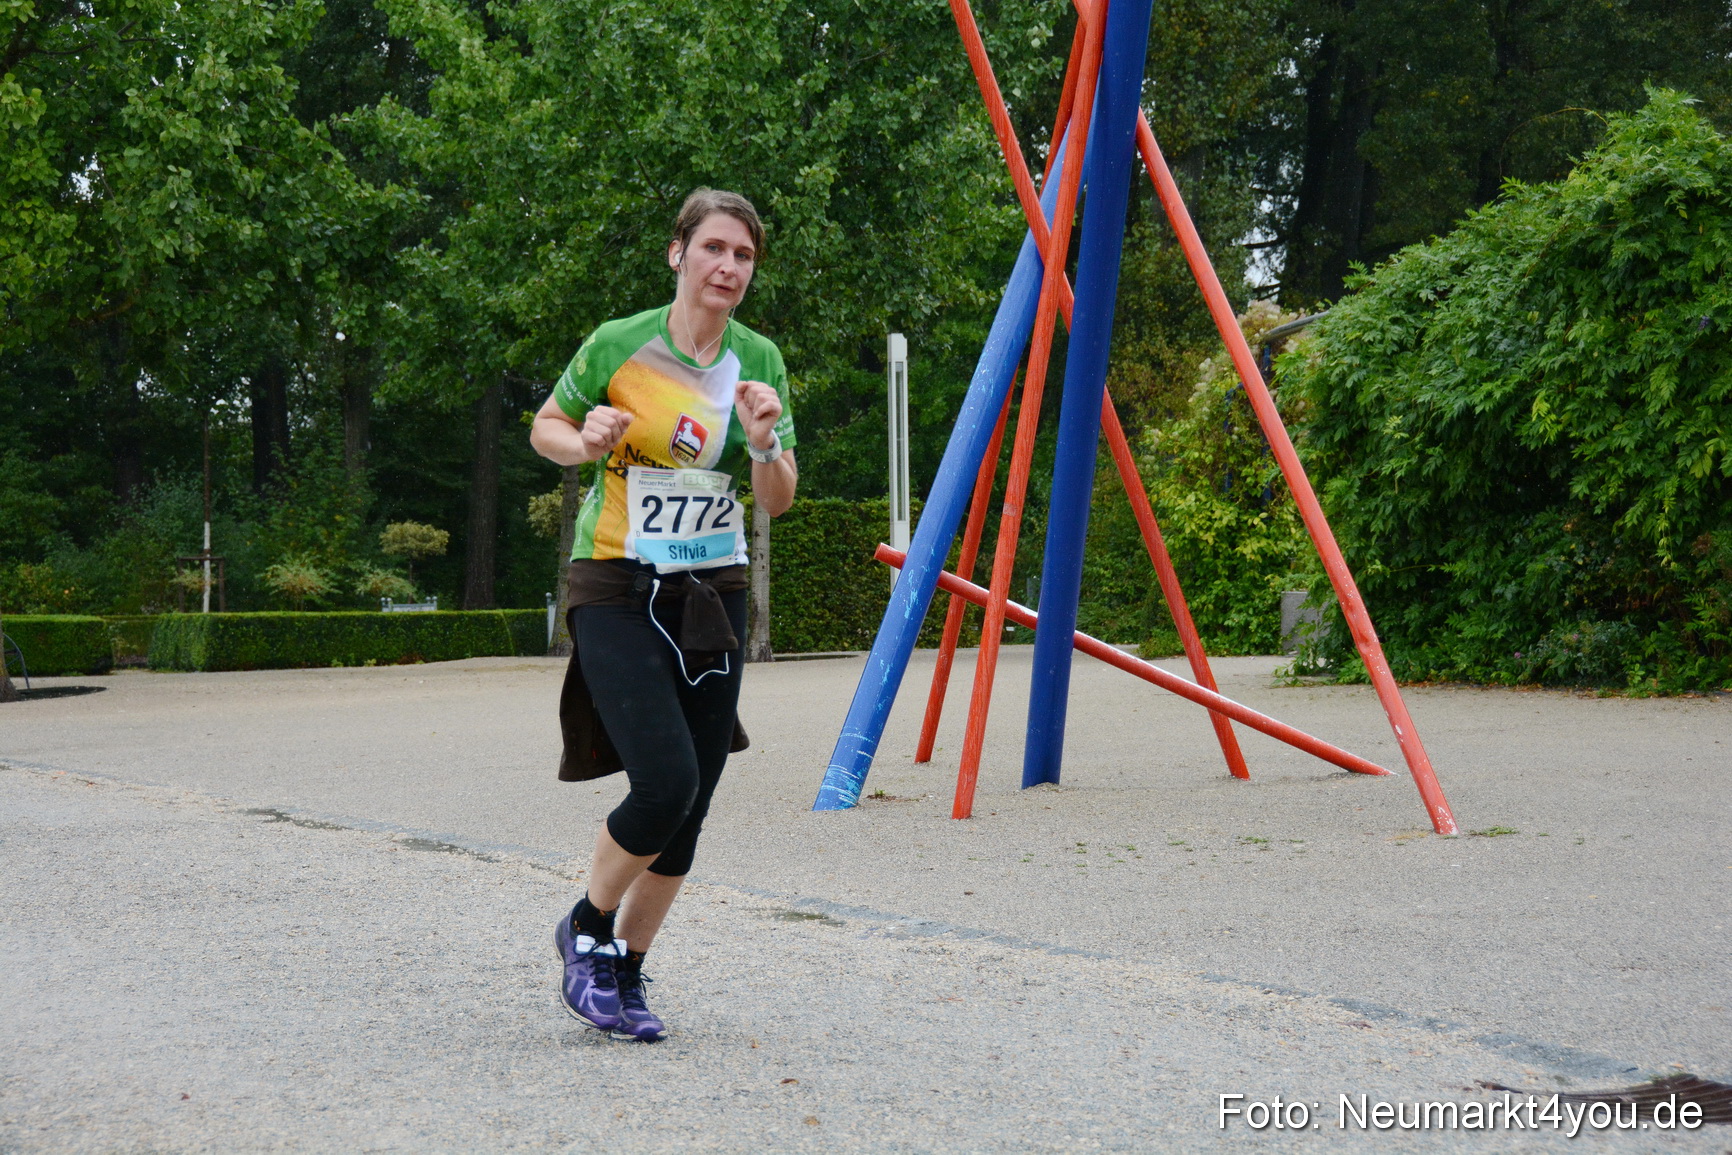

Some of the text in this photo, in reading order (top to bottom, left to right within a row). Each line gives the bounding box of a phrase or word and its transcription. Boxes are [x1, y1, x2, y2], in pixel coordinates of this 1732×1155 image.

[675, 450, 691, 463] 1628
[641, 495, 735, 534] 2772
[668, 543, 707, 560] Silvia
